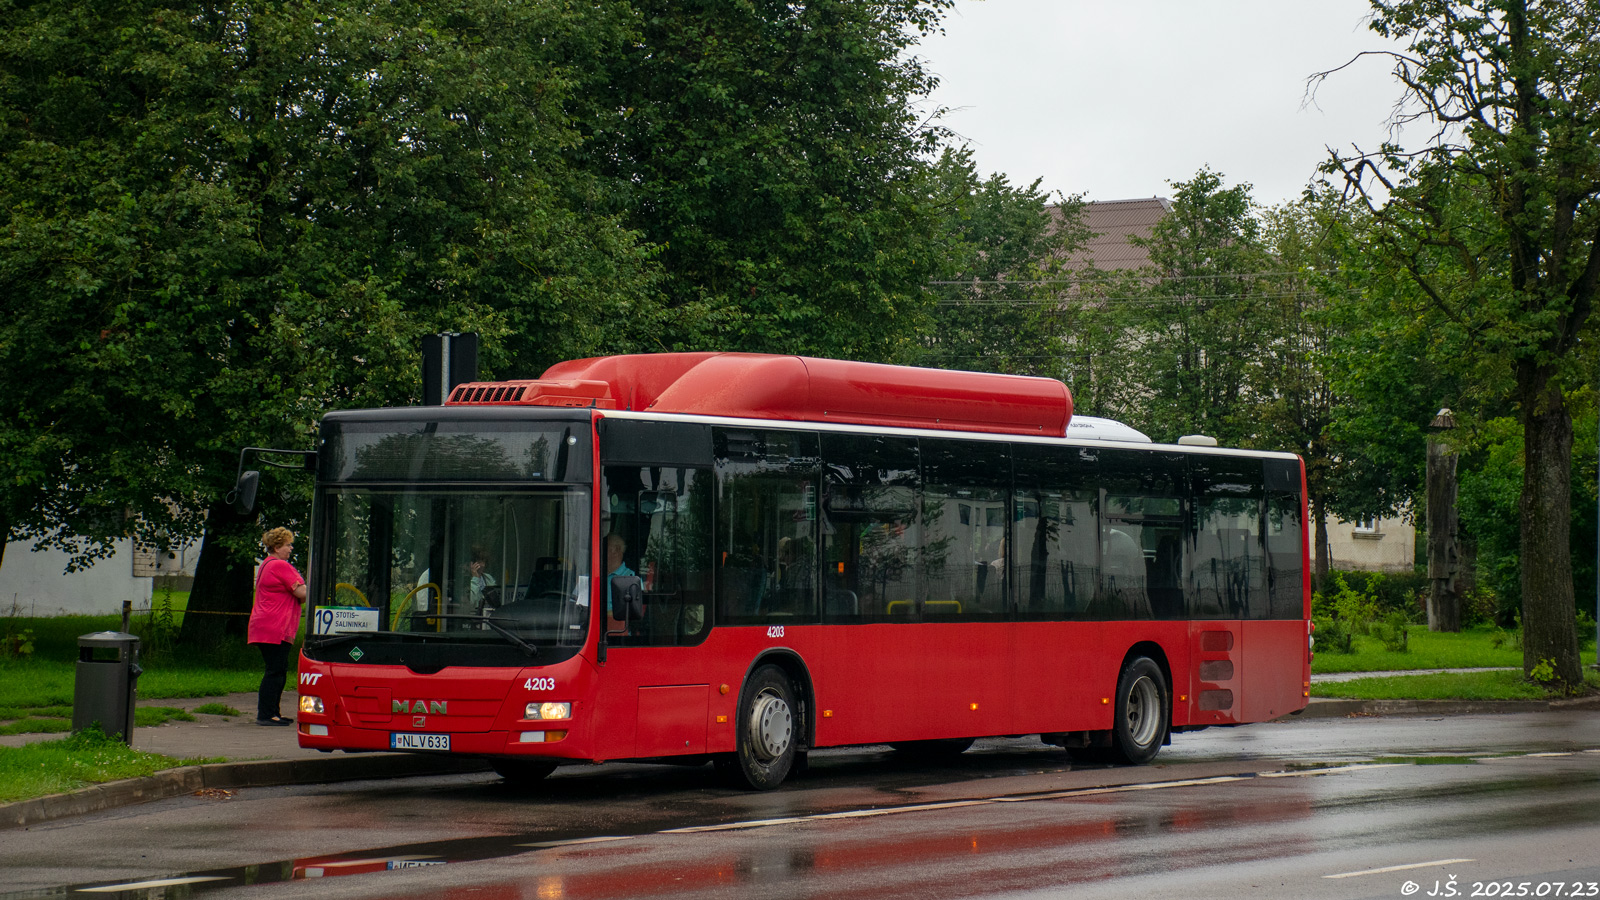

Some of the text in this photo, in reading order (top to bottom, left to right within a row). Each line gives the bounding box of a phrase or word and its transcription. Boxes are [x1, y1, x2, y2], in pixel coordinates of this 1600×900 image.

[315, 609, 334, 635] 19
[335, 620, 368, 628] SALININKAI
[766, 625, 785, 638] 4203
[523, 677, 555, 691] 4203
[392, 699, 448, 715] MAN
[402, 734, 448, 749] NLV633
